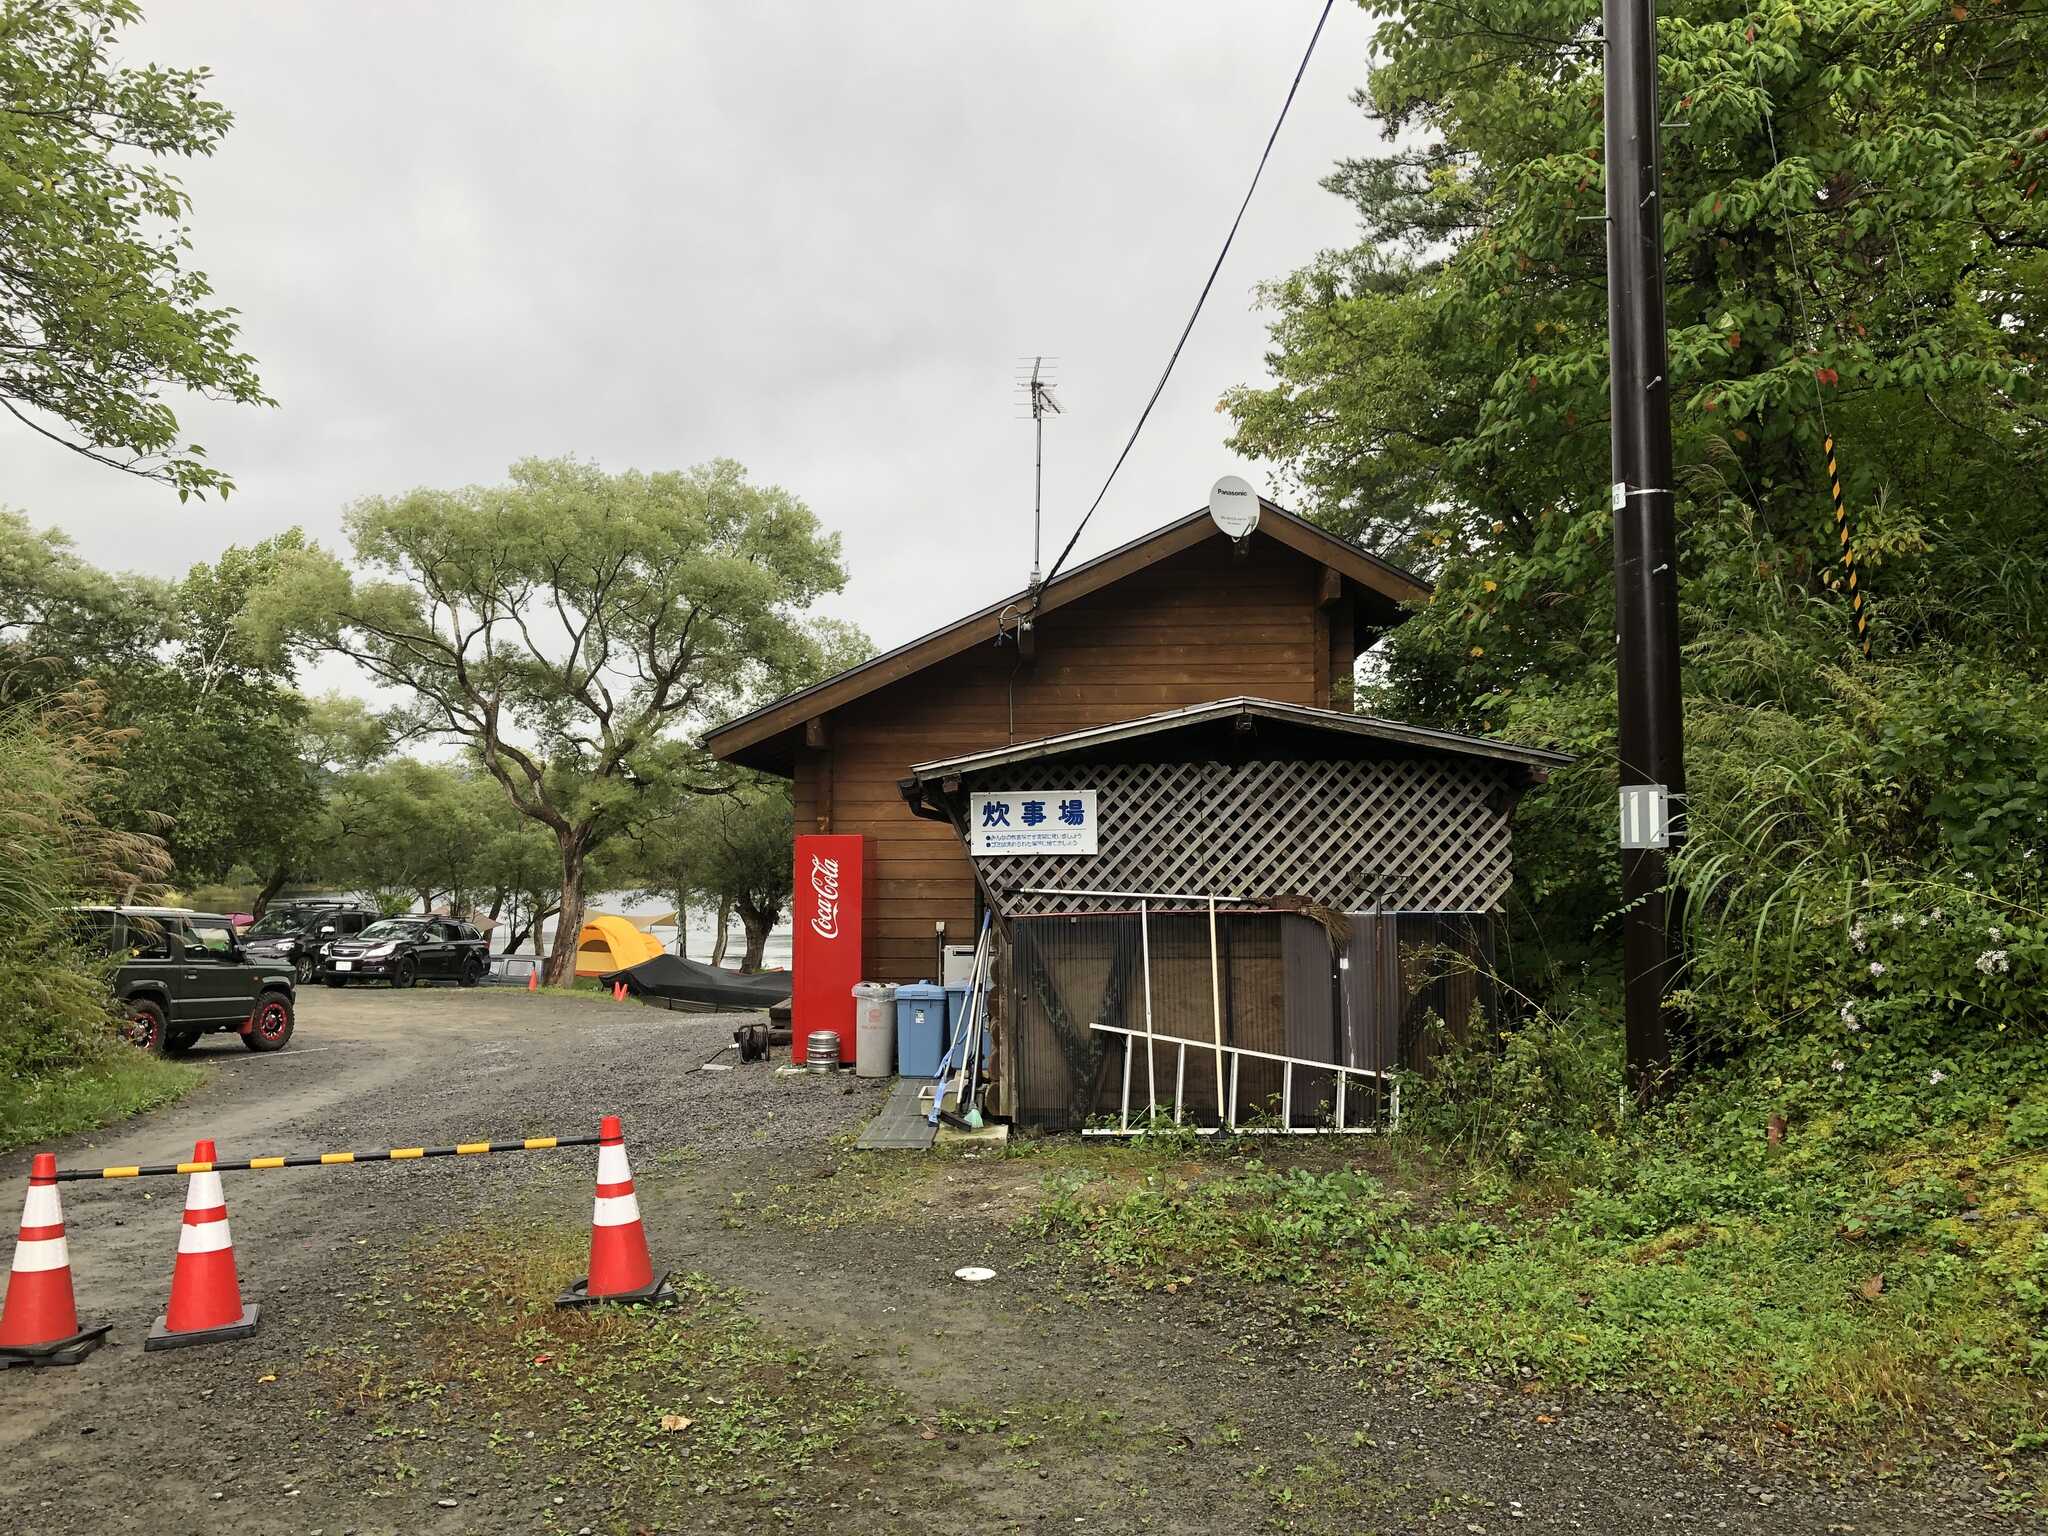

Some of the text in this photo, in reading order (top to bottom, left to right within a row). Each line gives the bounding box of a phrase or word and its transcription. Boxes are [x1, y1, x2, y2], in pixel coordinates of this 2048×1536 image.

[1217, 488, 1248, 497] Panasonic
[982, 799, 1085, 827] 炊事場
